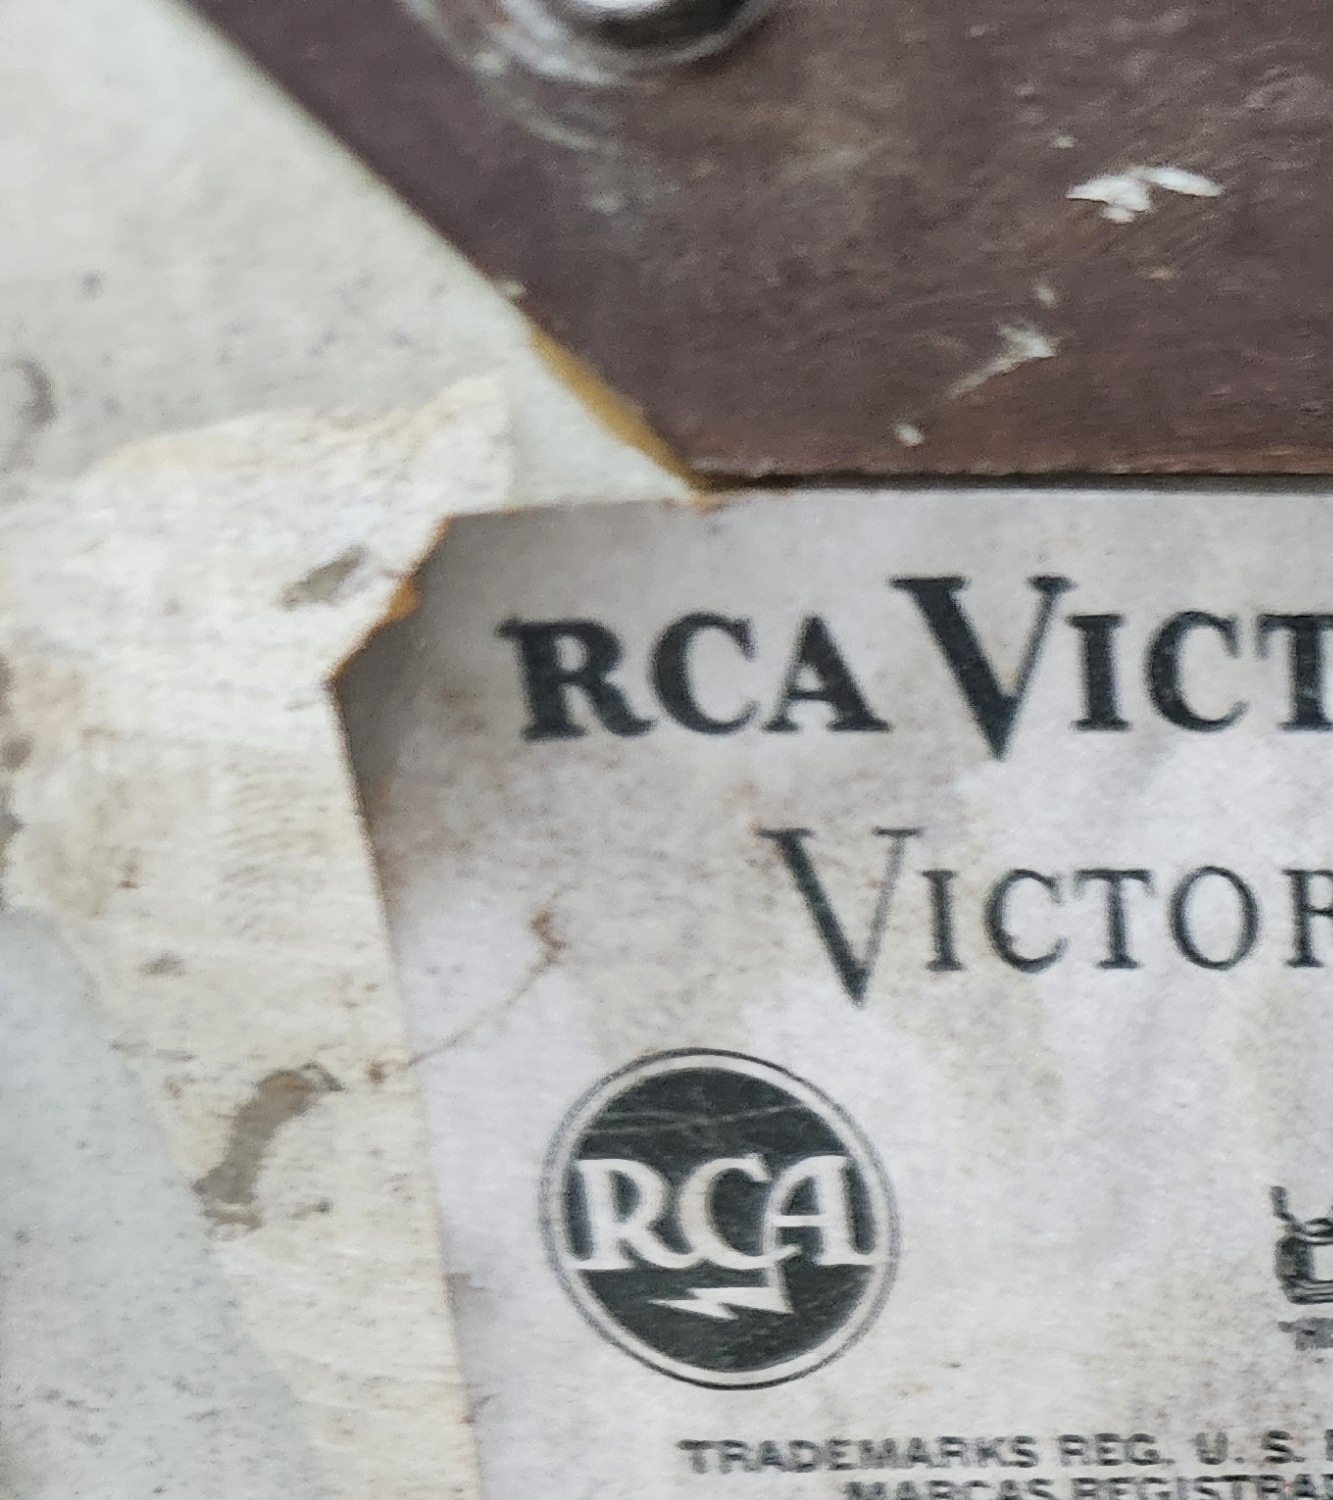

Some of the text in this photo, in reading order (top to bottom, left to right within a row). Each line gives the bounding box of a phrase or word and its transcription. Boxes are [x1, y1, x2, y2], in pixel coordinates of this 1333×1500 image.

[495, 612, 892, 741] RCA
[565, 1151, 878, 1271] RCA
[679, 1434, 1039, 1474] TRADEMARKS
[1058, 1431, 1174, 1468] REG.
